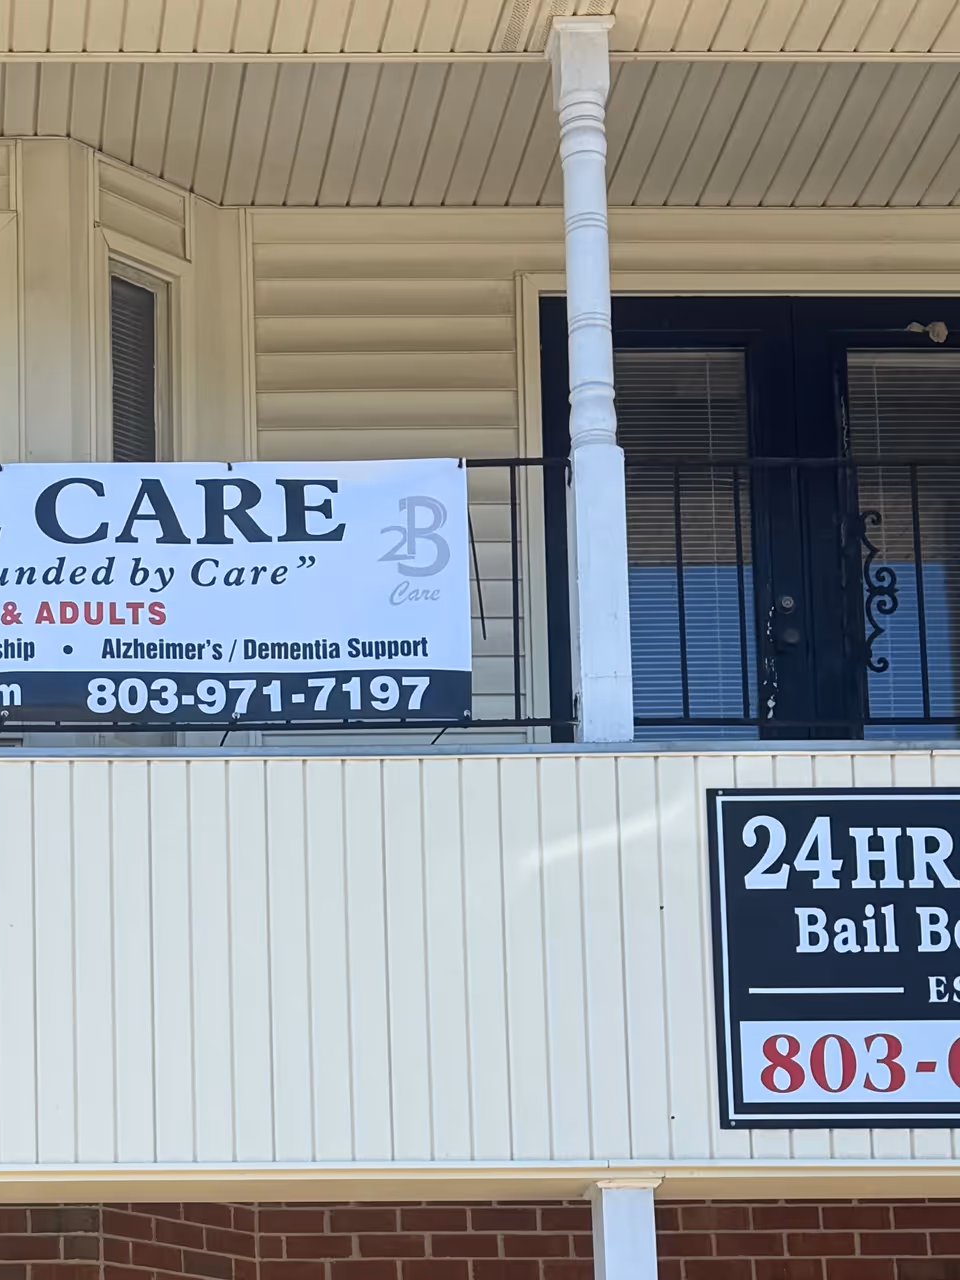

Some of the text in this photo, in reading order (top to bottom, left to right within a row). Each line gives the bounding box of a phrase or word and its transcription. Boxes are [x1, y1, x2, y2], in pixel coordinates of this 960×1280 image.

[35, 478, 346, 544] CARE
[130, 557, 174, 592] by
[191, 556, 315, 586] Care”
[389, 580, 440, 606] Care
[1, 602, 23, 626] &
[35, 602, 167, 626] ADULTS
[102, 638, 223, 661] Alzheimer’s
[244, 639, 340, 661] Dementia
[348, 637, 428, 661] Support
[87, 676, 430, 715] 803-971-7197
[795, 904, 960, 953] Bail B
[761, 1034, 960, 1094] 803-
